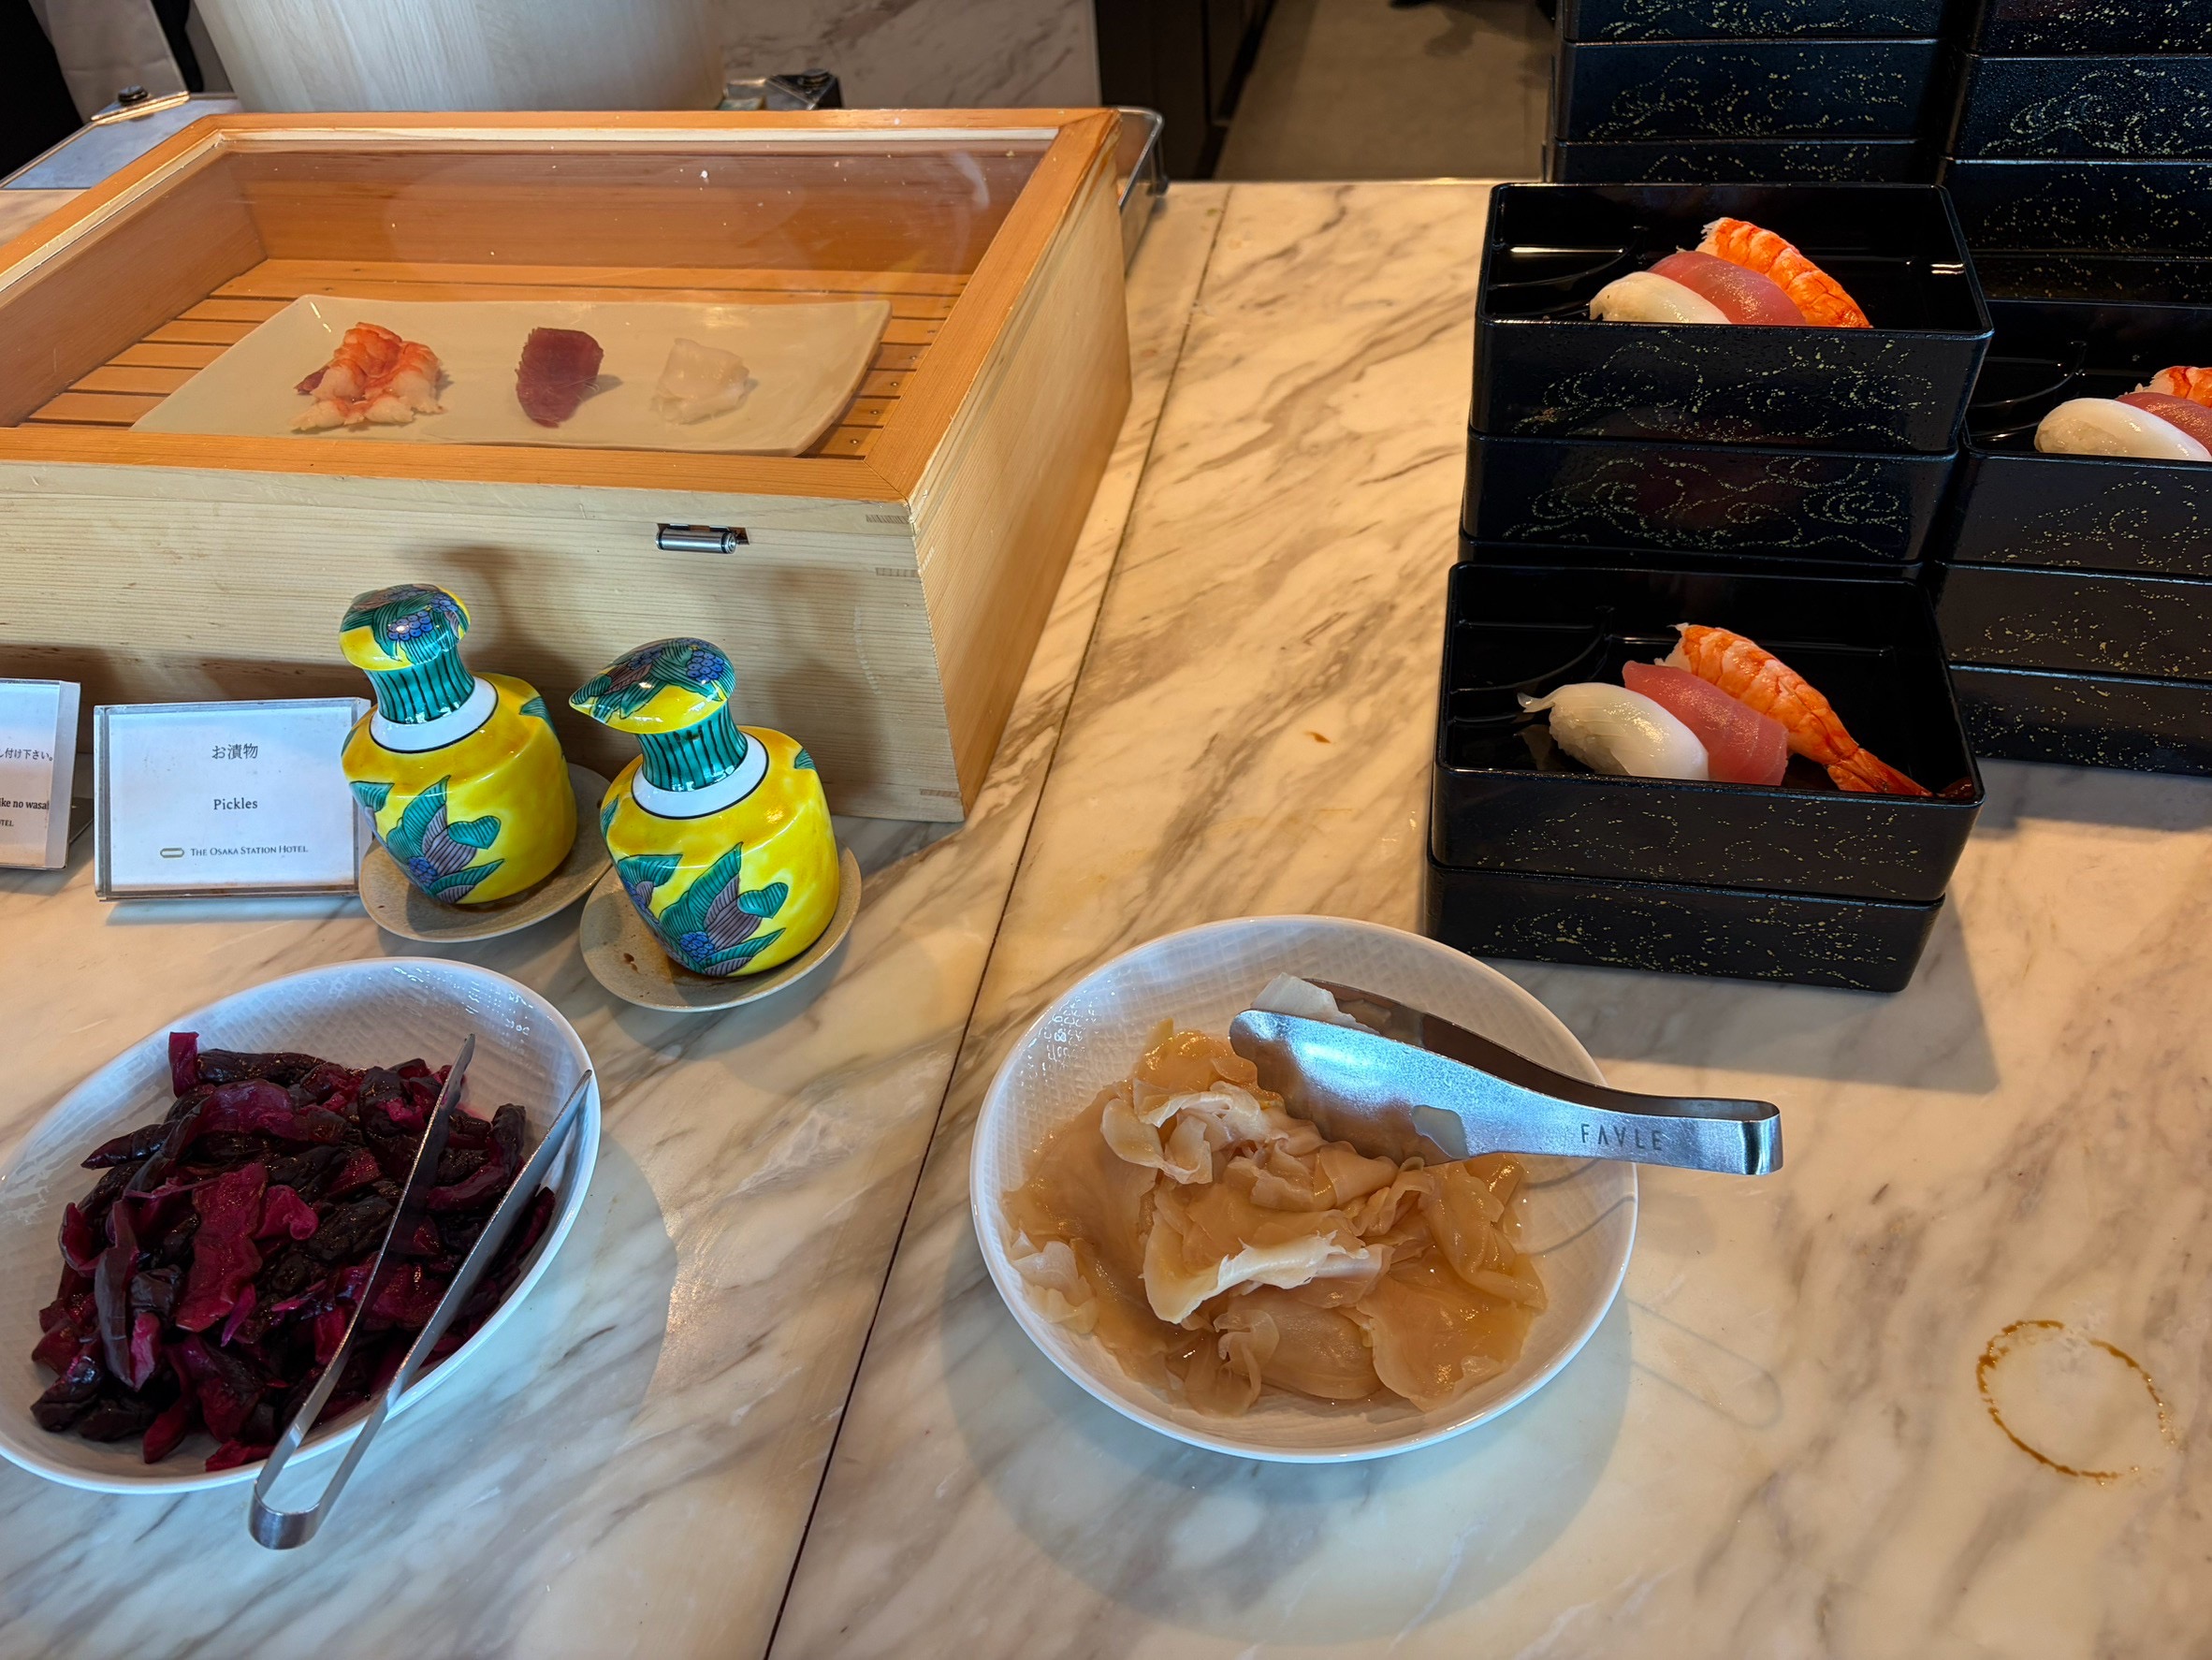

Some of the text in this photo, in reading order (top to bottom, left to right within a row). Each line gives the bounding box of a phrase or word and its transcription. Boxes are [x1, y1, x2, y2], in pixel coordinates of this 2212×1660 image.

[211, 743, 258, 760] お漬物
[12, 800, 24, 808] no
[213, 797, 258, 810] Pickles
[0, 819, 14, 827] TEL
[190, 845, 309, 856] THE OSAKA STATION HOTEL
